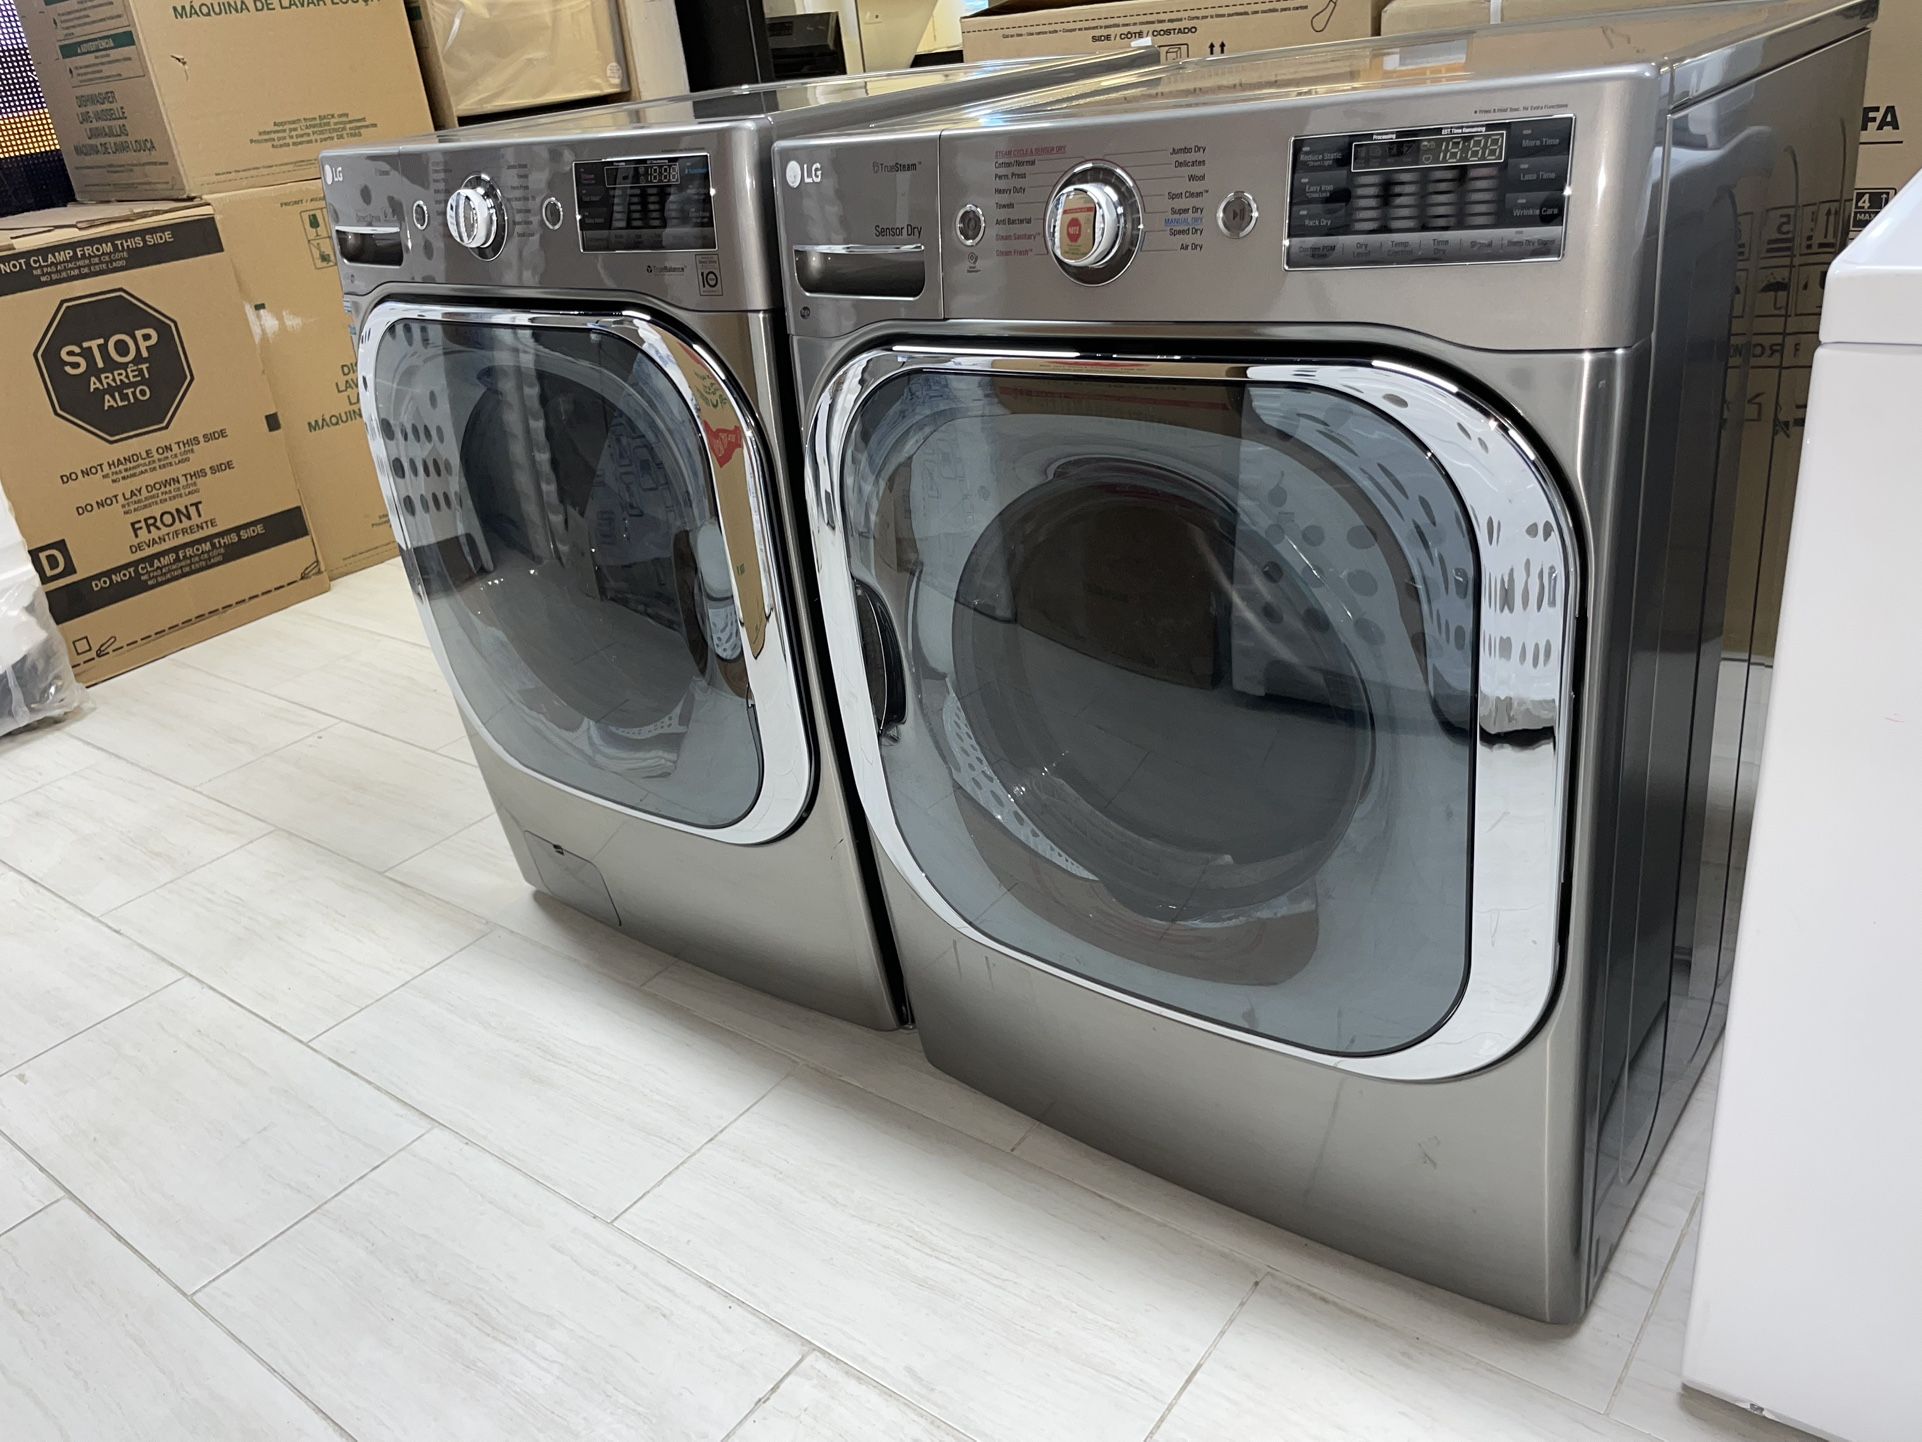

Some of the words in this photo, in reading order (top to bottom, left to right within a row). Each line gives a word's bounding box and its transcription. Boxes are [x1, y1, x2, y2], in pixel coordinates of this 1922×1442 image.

[172, 5, 250, 20] MÁQUINA
[254, 0, 275, 12] DE
[1091, 34, 1112, 43] SIDE
[1119, 30, 1144, 40] CÔTÉ
[1151, 26, 1197, 37] COSTADO
[1861, 105, 1900, 132] FA
[1372, 133, 1396, 141] Processing
[1522, 139, 1540, 147] More
[1542, 137, 1559, 145] Time
[130, 138, 156, 156] LOUÇA
[1170, 145, 1193, 156] Jumbo
[1194, 145, 1206, 154] Dry
[1439, 135, 1502, 163] 18:88
[994, 159, 1036, 169] Cotton/Normal
[1174, 159, 1206, 169] Delicates
[1300, 153, 1323, 161] Reduce
[1324, 152, 1342, 160] Static
[332, 166, 343, 182] LG
[803, 162, 822, 183] LG
[994, 173, 1009, 181] Perm.
[1187, 173, 1206, 182] Wool
[1520, 172, 1537, 180] Less
[1539, 171, 1556, 179] Time
[994, 187, 1011, 195] Heavy
[1013, 186, 1026, 195] Duty
[1167, 190, 1183, 200] Spot
[1858, 193, 1870, 210] 4
[1170, 207, 1190, 216] Super
[1191, 206, 1204, 215] Dry
[1513, 207, 1540, 216] Wrinkle
[1541, 207, 1558, 215] Care
[1007, 216, 1032, 225] Bacterial
[1165, 218, 1191, 226] MANUAL
[1191, 217, 1204, 225] DRY
[874, 225, 904, 238] Sensor
[906, 224, 923, 239] Dry
[1169, 228, 1190, 237] Speed
[1191, 227, 1204, 236] Dry
[1180, 243, 1190, 251] Air
[1191, 242, 1204, 251] Dry
[1356, 241, 1369, 250] Dry
[1432, 238, 1449, 247] Time
[1470, 240, 1493, 249] Signal
[0, 259, 26, 275] NOT
[30, 250, 74, 268] CLAMP
[76, 243, 113, 259] FROM
[115, 237, 143, 252] THIS
[145, 231, 174, 246] SIDE
[1433, 247, 1446, 256] Dry
[44, 266, 57, 274] PAS
[57, 259, 89, 273] ATTACHER
[111, 252, 128, 261] CÔTÉ
[51, 269, 79, 281] SUJETAR
[91, 263, 107, 273] ESTE
[108, 259, 127, 269] LADO
[701, 271, 718, 288] 10
[60, 328, 158, 375] STOP
[89, 363, 150, 393] ARRÊT
[104, 385, 151, 411] ALTO
[60, 472, 79, 485] DO
[80, 464, 105, 480] NOT
[107, 448, 154, 470] HANDLE
[156, 444, 173, 457] ON
[173, 436, 201, 451] THIS
[202, 428, 228, 443] SIDE
[112, 470, 123, 478] PAS
[123, 460, 157, 475] MANIPULER
[121, 469, 149, 482] MANEJAR
[159, 462, 174, 471] ESTE
[174, 456, 191, 467] LADO
[75, 503, 94, 516] DO
[95, 494, 120, 510] NOT
[121, 486, 144, 501] LAY
[145, 475, 181, 493] DOWN
[182, 467, 208, 483] THIS
[209, 460, 235, 475] SIDE
[169, 493, 183, 503] ESTE
[183, 487, 200, 498] LADO
[129, 501, 204, 539] FRONT
[129, 518, 218, 554] DEVANT/FRENTE
[38, 549, 65, 577] D
[92, 578, 110, 591] DO
[112, 569, 136, 585] NOT
[138, 553, 177, 575] CLAMP
[179, 543, 212, 560] FROM
[213, 533, 239, 549] THIS
[240, 523, 265, 540] SIDE
[162, 559, 191, 574] ATTACHER
[158, 570, 183, 583] SUJETAR
